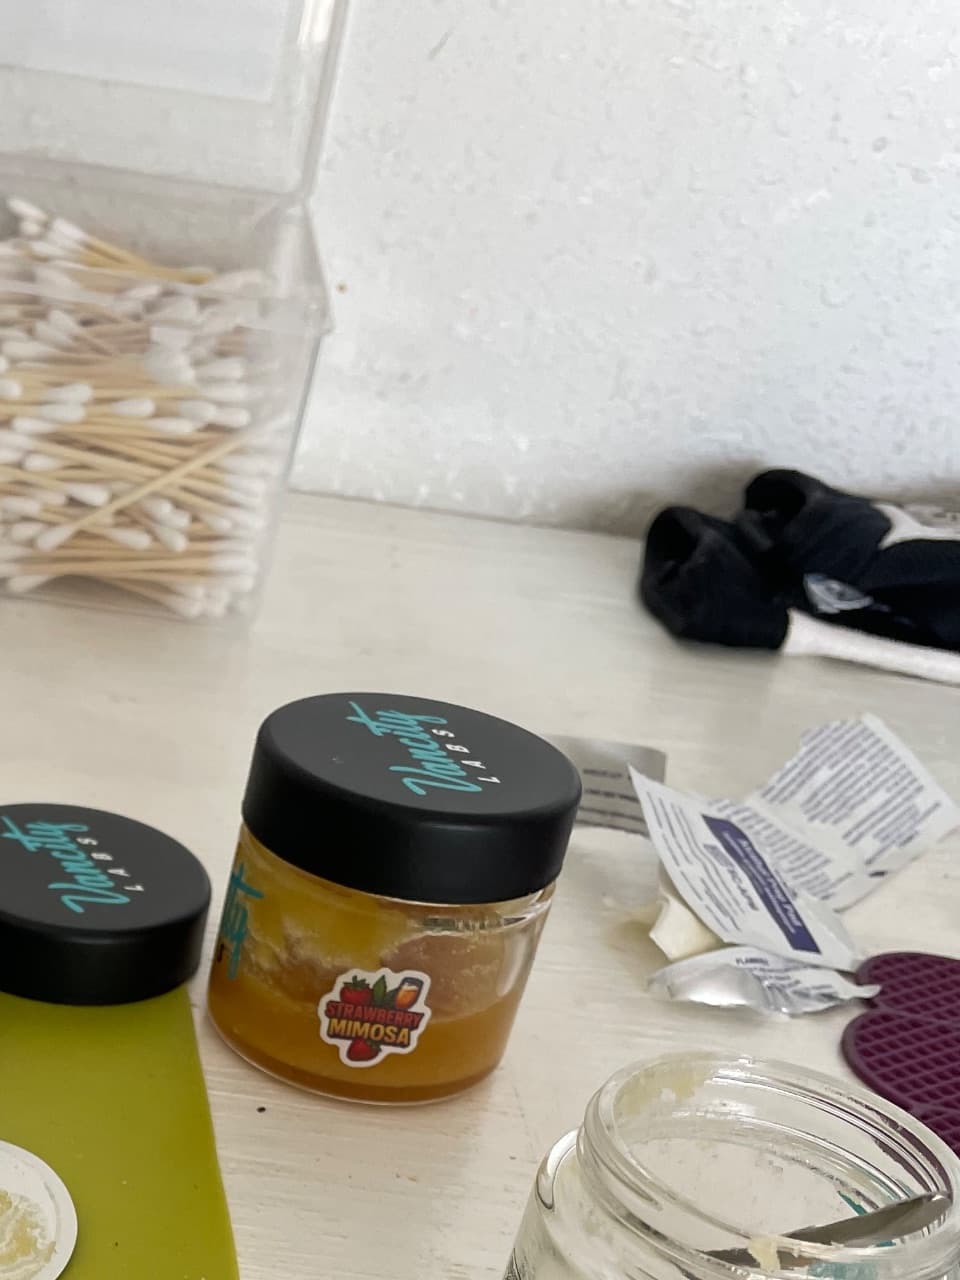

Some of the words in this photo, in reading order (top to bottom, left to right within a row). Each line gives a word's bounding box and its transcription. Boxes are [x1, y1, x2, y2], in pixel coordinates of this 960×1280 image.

[431, 727, 502, 785] LABS
[75, 836, 145, 892] LABS
[326, 1002, 422, 1028] STRAWBERRY
[329, 1018, 410, 1046] MIMOSA
